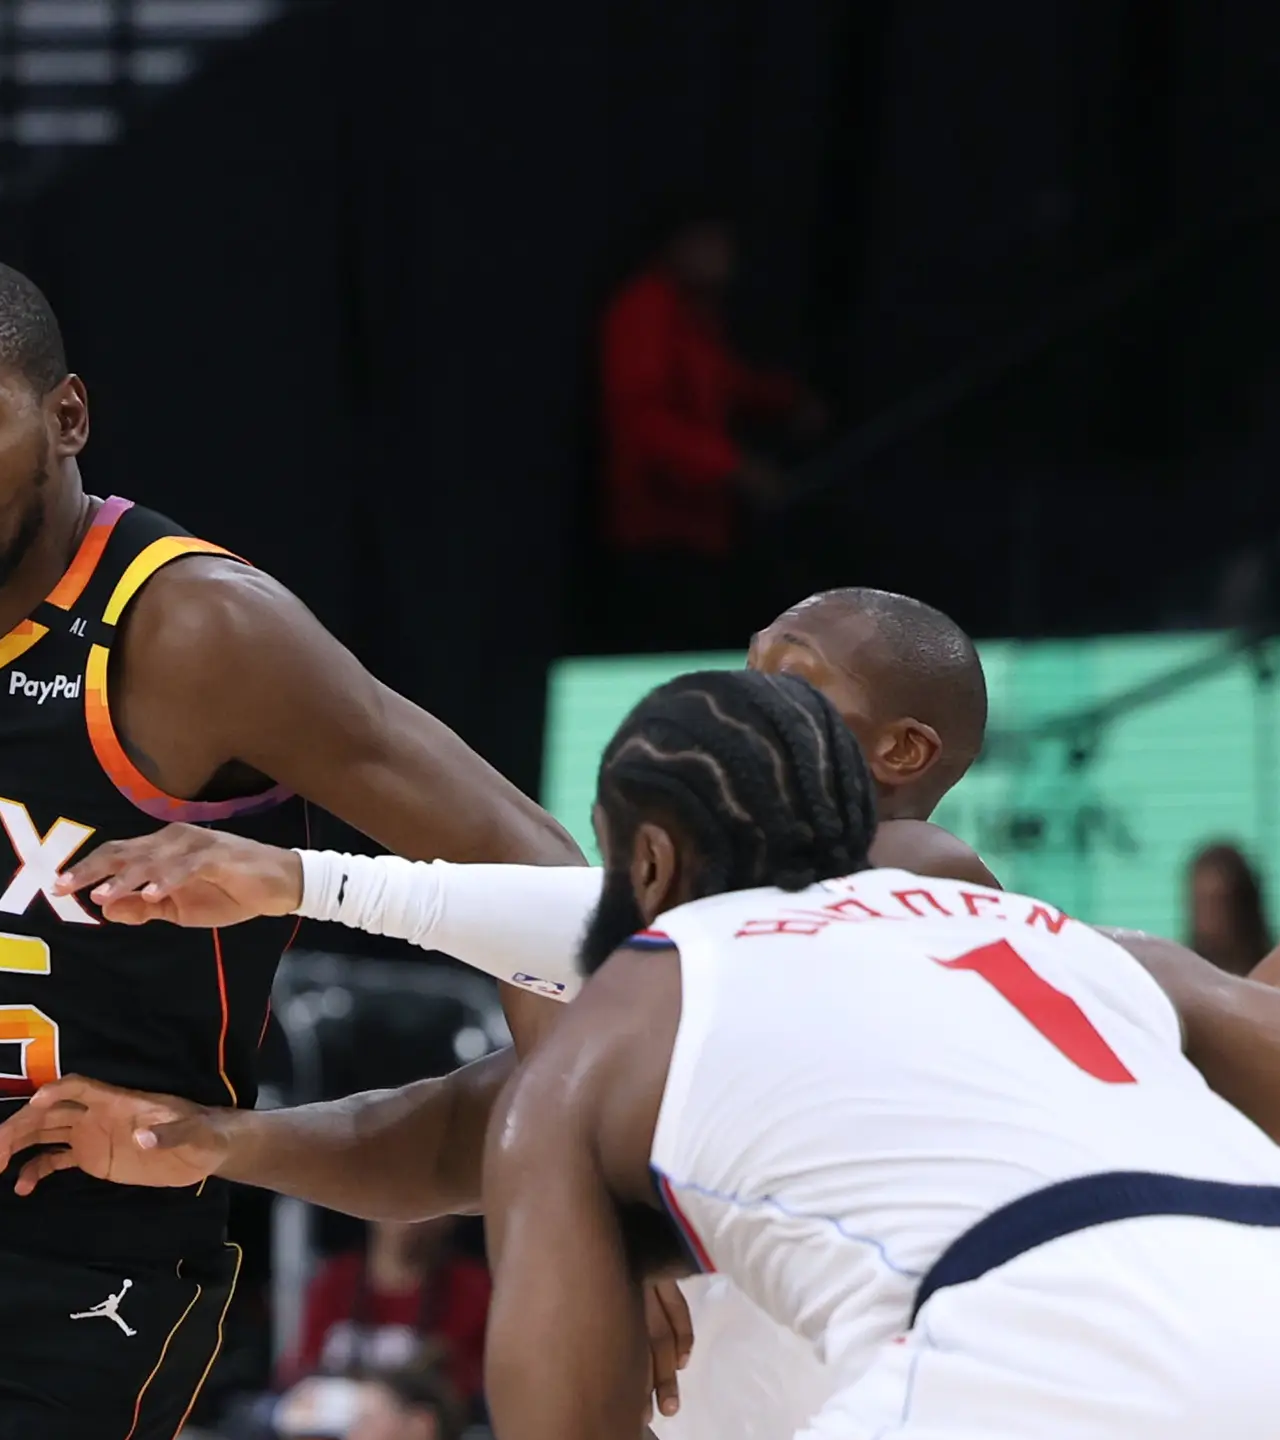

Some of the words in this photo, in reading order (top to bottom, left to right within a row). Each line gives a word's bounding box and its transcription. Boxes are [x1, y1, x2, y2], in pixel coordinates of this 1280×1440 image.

[69, 617, 87, 638] AL
[8, 670, 82, 705] PayPal
[928, 938, 1138, 1084] 1
